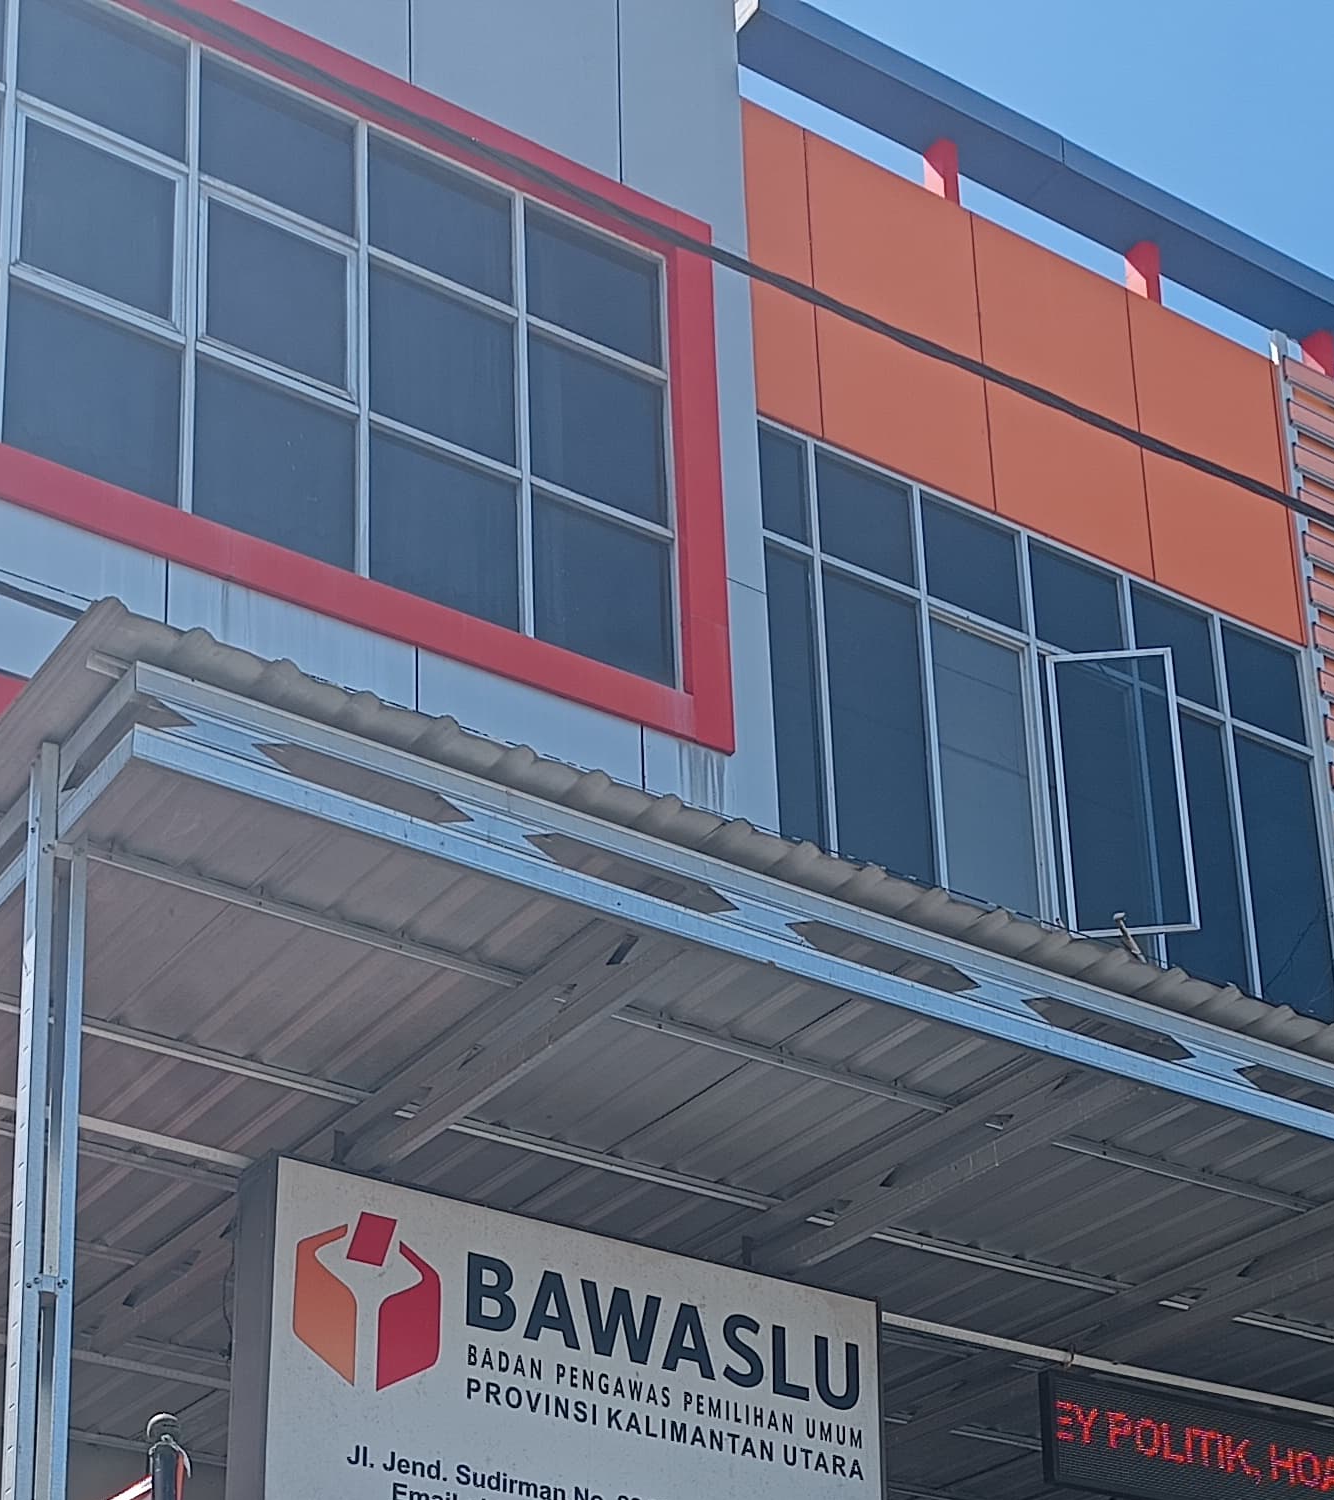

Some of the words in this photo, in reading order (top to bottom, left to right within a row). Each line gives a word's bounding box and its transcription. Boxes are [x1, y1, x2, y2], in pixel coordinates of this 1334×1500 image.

[465, 1251, 860, 1411] BAWASLU
[465, 1378, 598, 1427] PROVINSI
[607, 1404, 775, 1463] KALIMANTAN
[782, 1446, 865, 1482] UTARA
[466, 1344, 543, 1382] BADAN
[555, 1364, 672, 1409] PENGAWAS
[683, 1391, 795, 1435] PEMILIHAN
[805, 1418, 864, 1450] UMUM
[1106, 1411, 1263, 1487] POLITIK,
[346, 1444, 375, 1469] Jl.
[382, 1451, 448, 1482] Jend.
